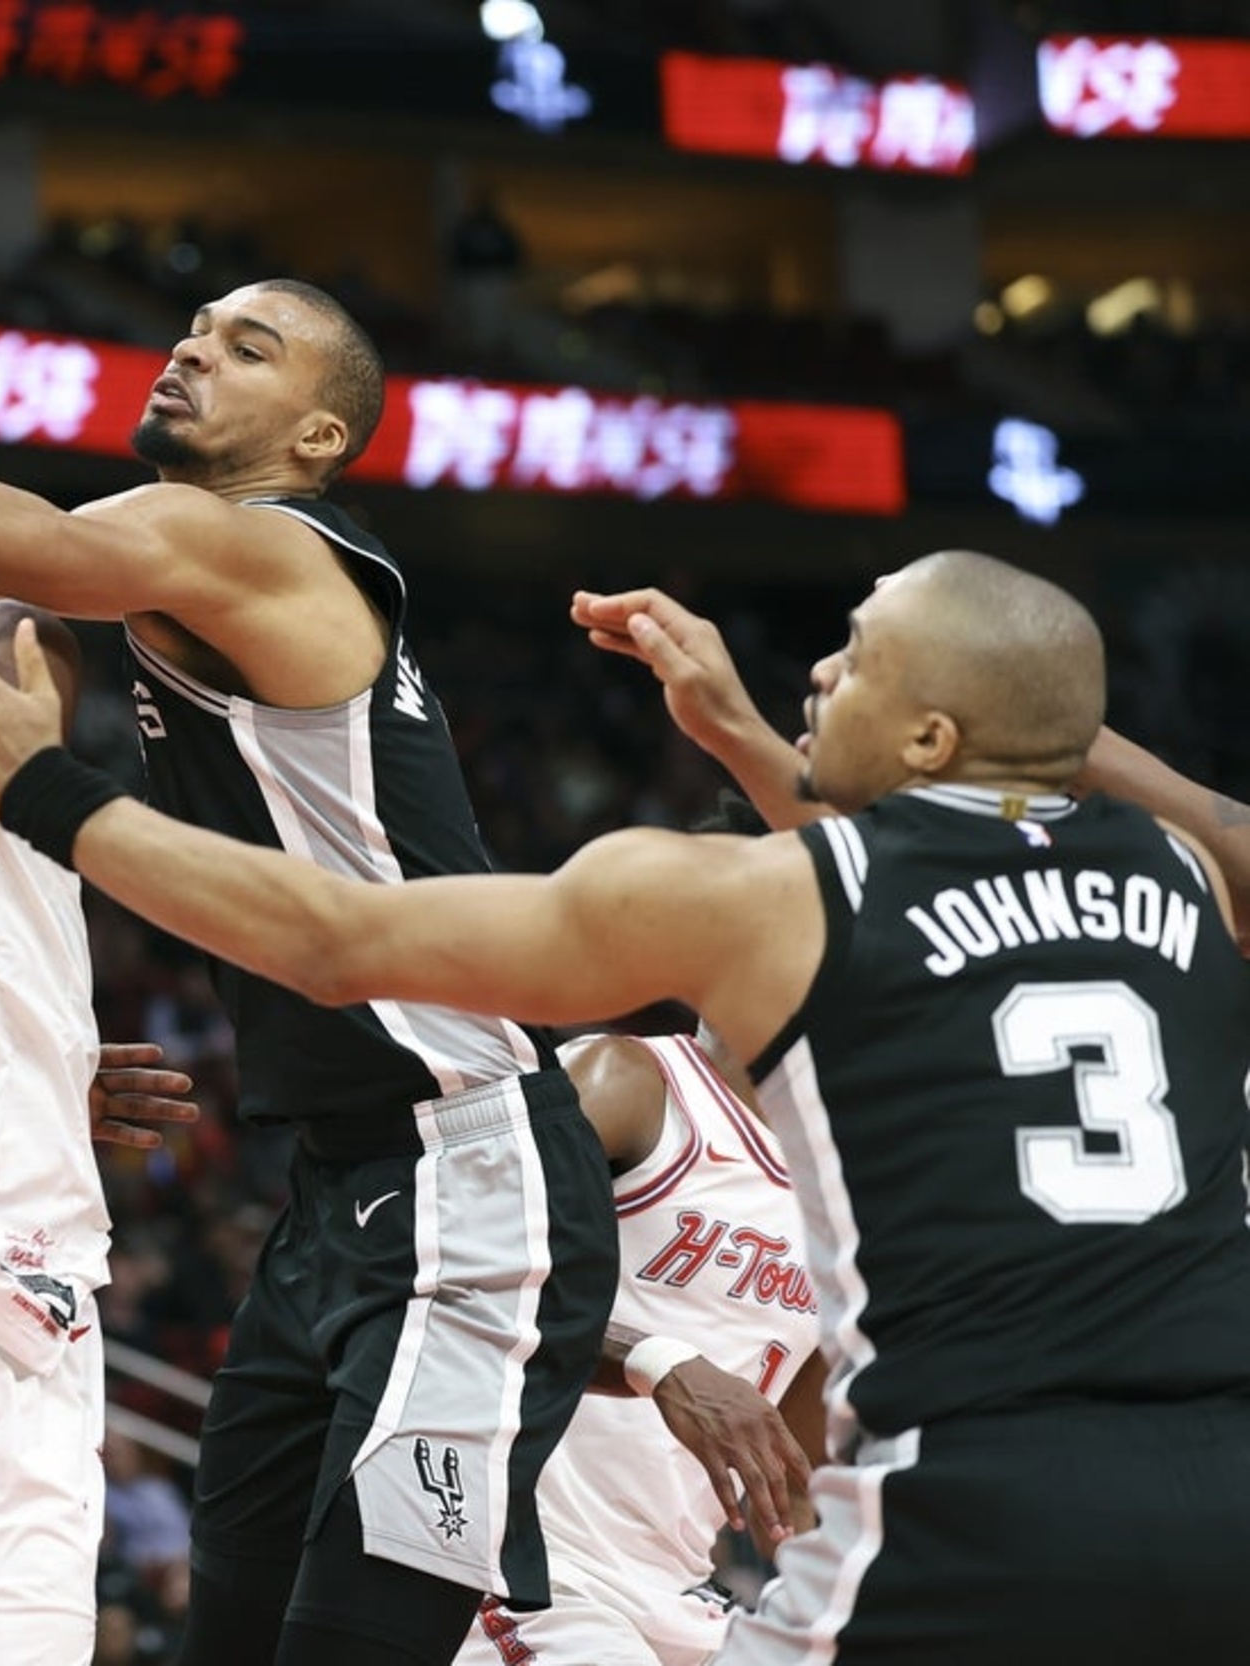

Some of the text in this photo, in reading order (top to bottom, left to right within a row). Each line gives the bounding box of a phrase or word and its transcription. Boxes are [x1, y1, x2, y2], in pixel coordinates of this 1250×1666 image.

[905, 868, 1199, 977] JOHNSON
[990, 980, 1188, 1225] 3
[758, 1340, 791, 1396] 1
